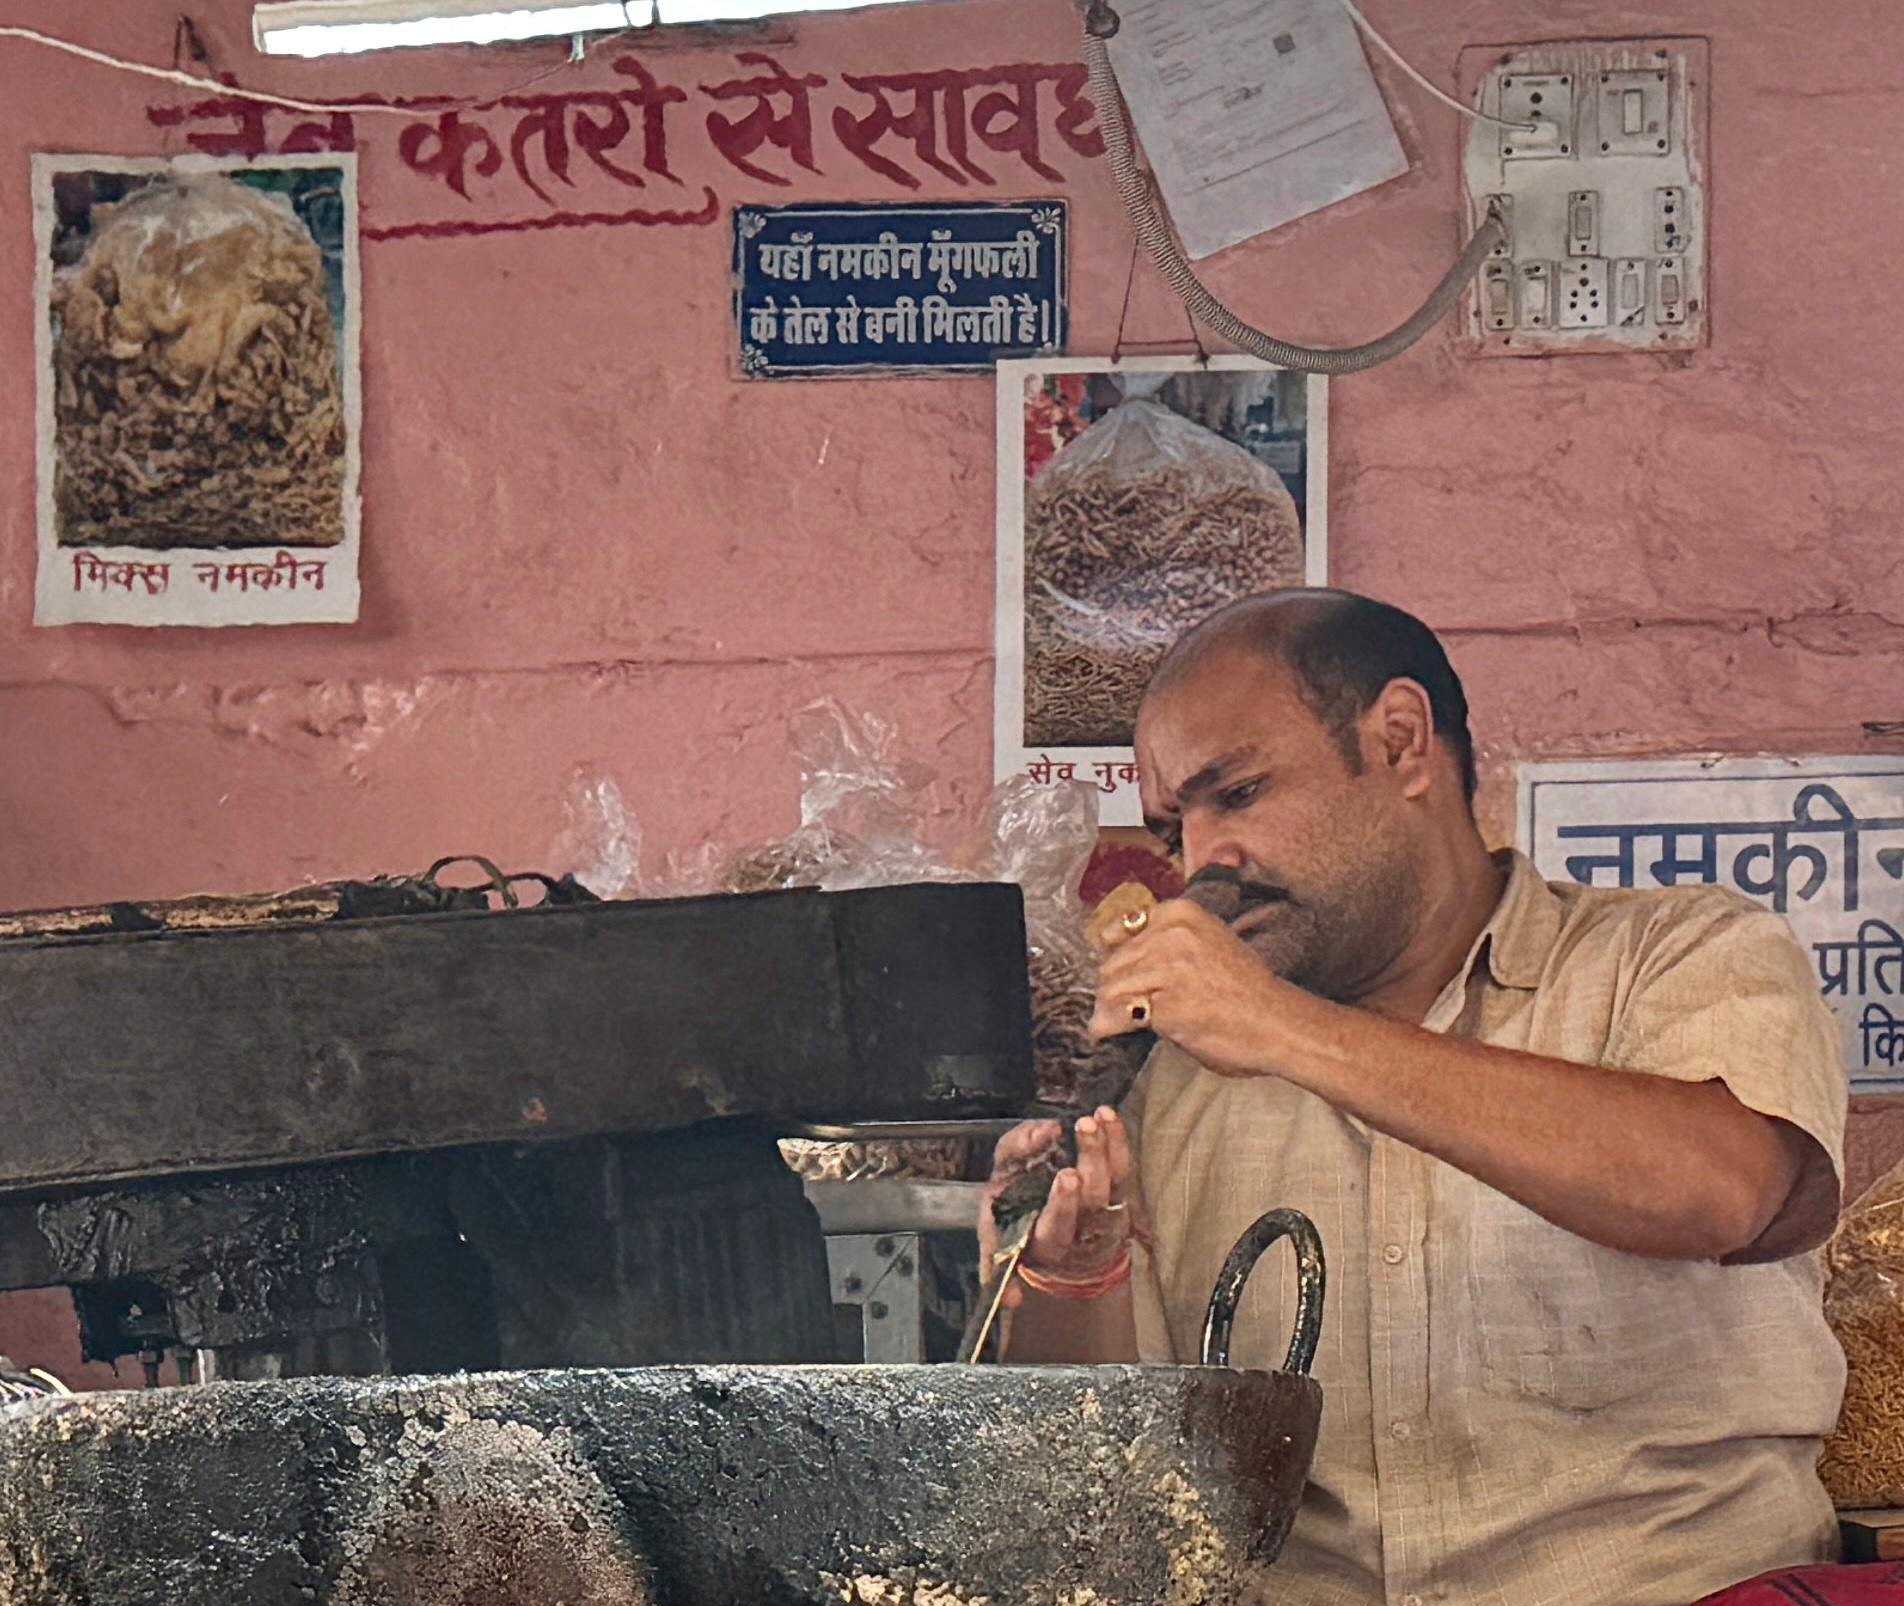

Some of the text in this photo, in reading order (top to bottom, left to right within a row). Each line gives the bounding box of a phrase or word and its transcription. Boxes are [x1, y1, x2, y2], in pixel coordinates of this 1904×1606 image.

[394, 56, 687, 206] कतरो
[699, 52, 827, 187] से
[833, 63, 1109, 190] सावध
[817, 231, 923, 280] नमकीन
[750, 295, 778, 343] के
[783, 294, 831, 344] तेल
[835, 294, 862, 343] से
[864, 295, 919, 343] बनी
[922, 294, 1014, 343] मिलती
[72, 549, 328, 594] मिक्स नमकीन
[1026, 753, 1141, 793] सेव नुक
